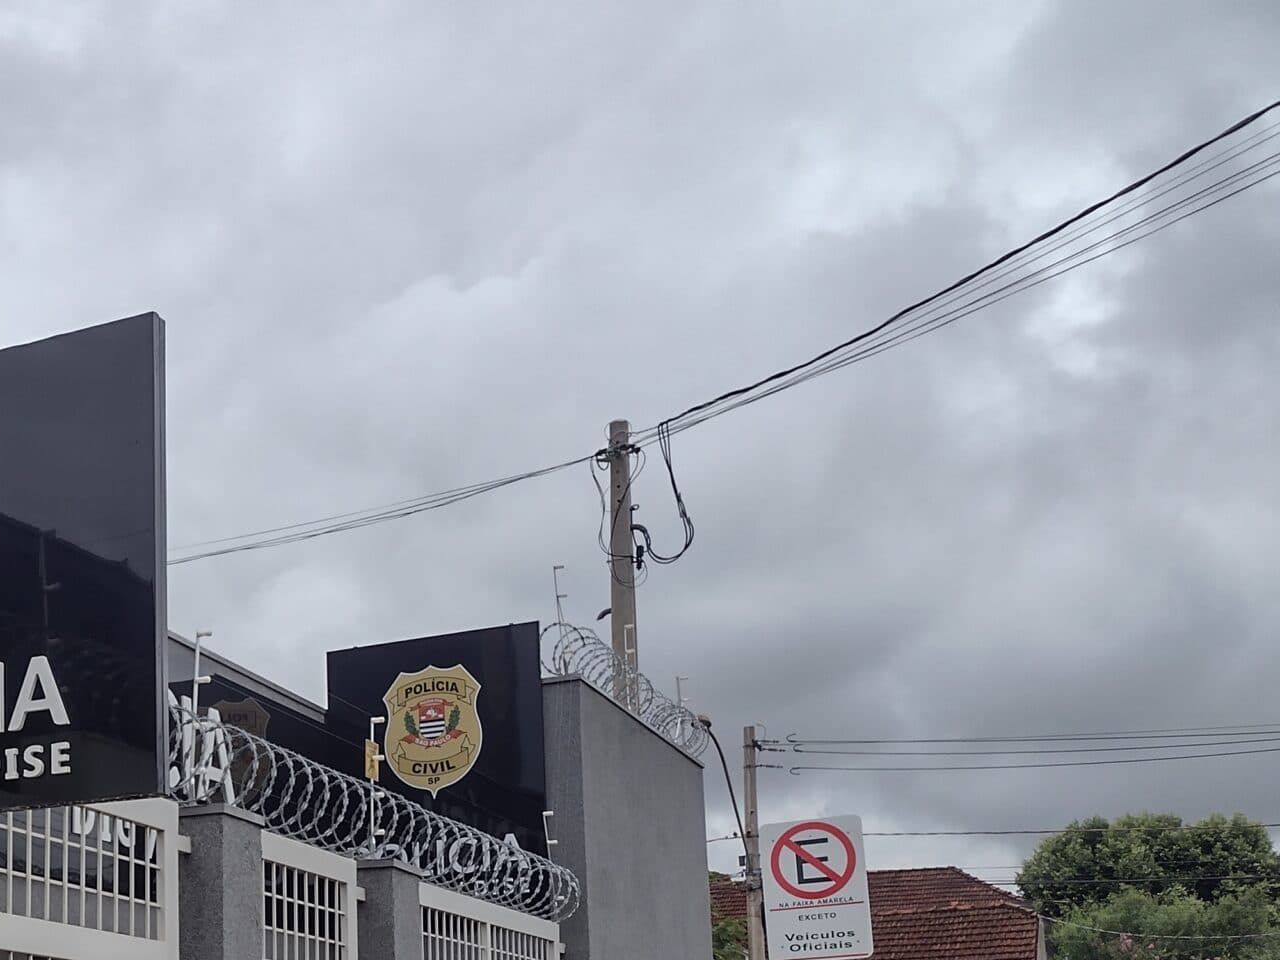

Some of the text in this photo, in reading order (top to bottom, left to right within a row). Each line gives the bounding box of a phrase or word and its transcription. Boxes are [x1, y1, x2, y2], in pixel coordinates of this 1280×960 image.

[404, 678, 460, 699] POLÍCIA
[430, 734, 452, 747] PAULO
[412, 760, 456, 774] CIVIL
[427, 777, 440, 785] SP
[817, 896, 854, 905] AMARELA
[798, 912, 837, 922] EXCETO
[790, 940, 853, 952] Oficiais
